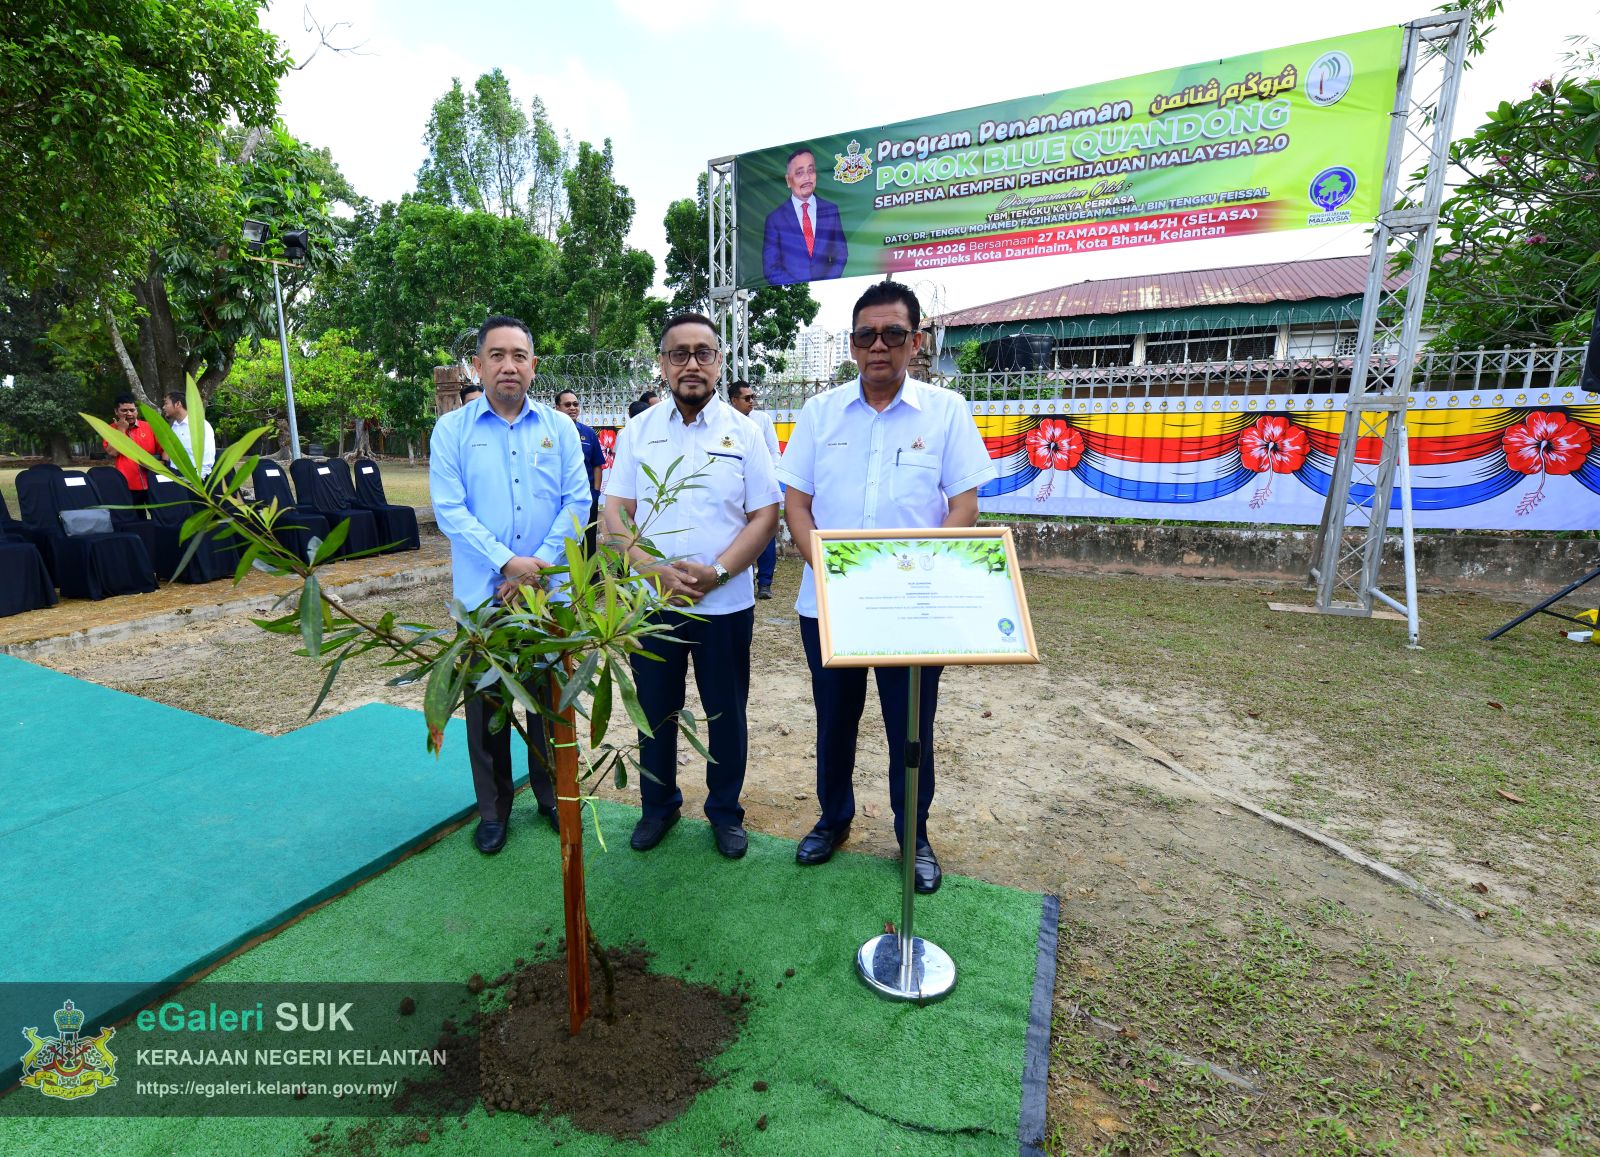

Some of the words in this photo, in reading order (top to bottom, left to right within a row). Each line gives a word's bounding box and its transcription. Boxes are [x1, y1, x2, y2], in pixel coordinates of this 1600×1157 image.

[876, 150, 979, 191] POKOK
[983, 136, 1067, 174] BLUE
[1071, 98, 1291, 162] QUANDONG
[877, 130, 971, 161] Program
[979, 100, 1132, 143] Penanaman
[874, 188, 945, 209] SEMPENA
[949, 176, 1016, 198] KEMPEN
[1020, 156, 1146, 187] PENGHIJAUAN
[1150, 140, 1251, 168] MALAYSIA
[1256, 135, 1288, 153] 2.0
[1090, 180, 1125, 199] Oleh
[894, 250, 904, 260] 17
[907, 247, 933, 258] MAC
[936, 243, 966, 255] 2026
[969, 235, 1034, 251] Bersamaan
[1038, 232, 1053, 243] 27
[1056, 223, 1130, 241] RAMADAN
[1133, 217, 1178, 231] 1447H
[1181, 208, 1258, 227] (SELASA)
[913, 231, 928, 240] DR.
[930, 226, 967, 238] TENGKU
[969, 220, 1018, 233] MOHAMED
[1020, 209, 1101, 226] FAZIHARUDEAN
[1104, 203, 1144, 216] AL-HAJ
[1147, 200, 1166, 210] BIN
[1170, 194, 1217, 207] TENGKU
[1220, 187, 1269, 201] FEISSAL
[987, 212, 1008, 222] YBM
[1010, 205, 1051, 218] TENGKU
[1053, 202, 1081, 213] KAYA
[1085, 195, 1135, 209] PERKASA
[1308, 215, 1349, 224] MALAYSIA
[914, 254, 970, 268] Kompleks
[973, 250, 1002, 261] Kota
[1005, 242, 1073, 259] Darulnaim,
[1076, 237, 1107, 250] Kota
[1111, 232, 1156, 246] Bharu,
[1160, 225, 1226, 241] Kelantan
